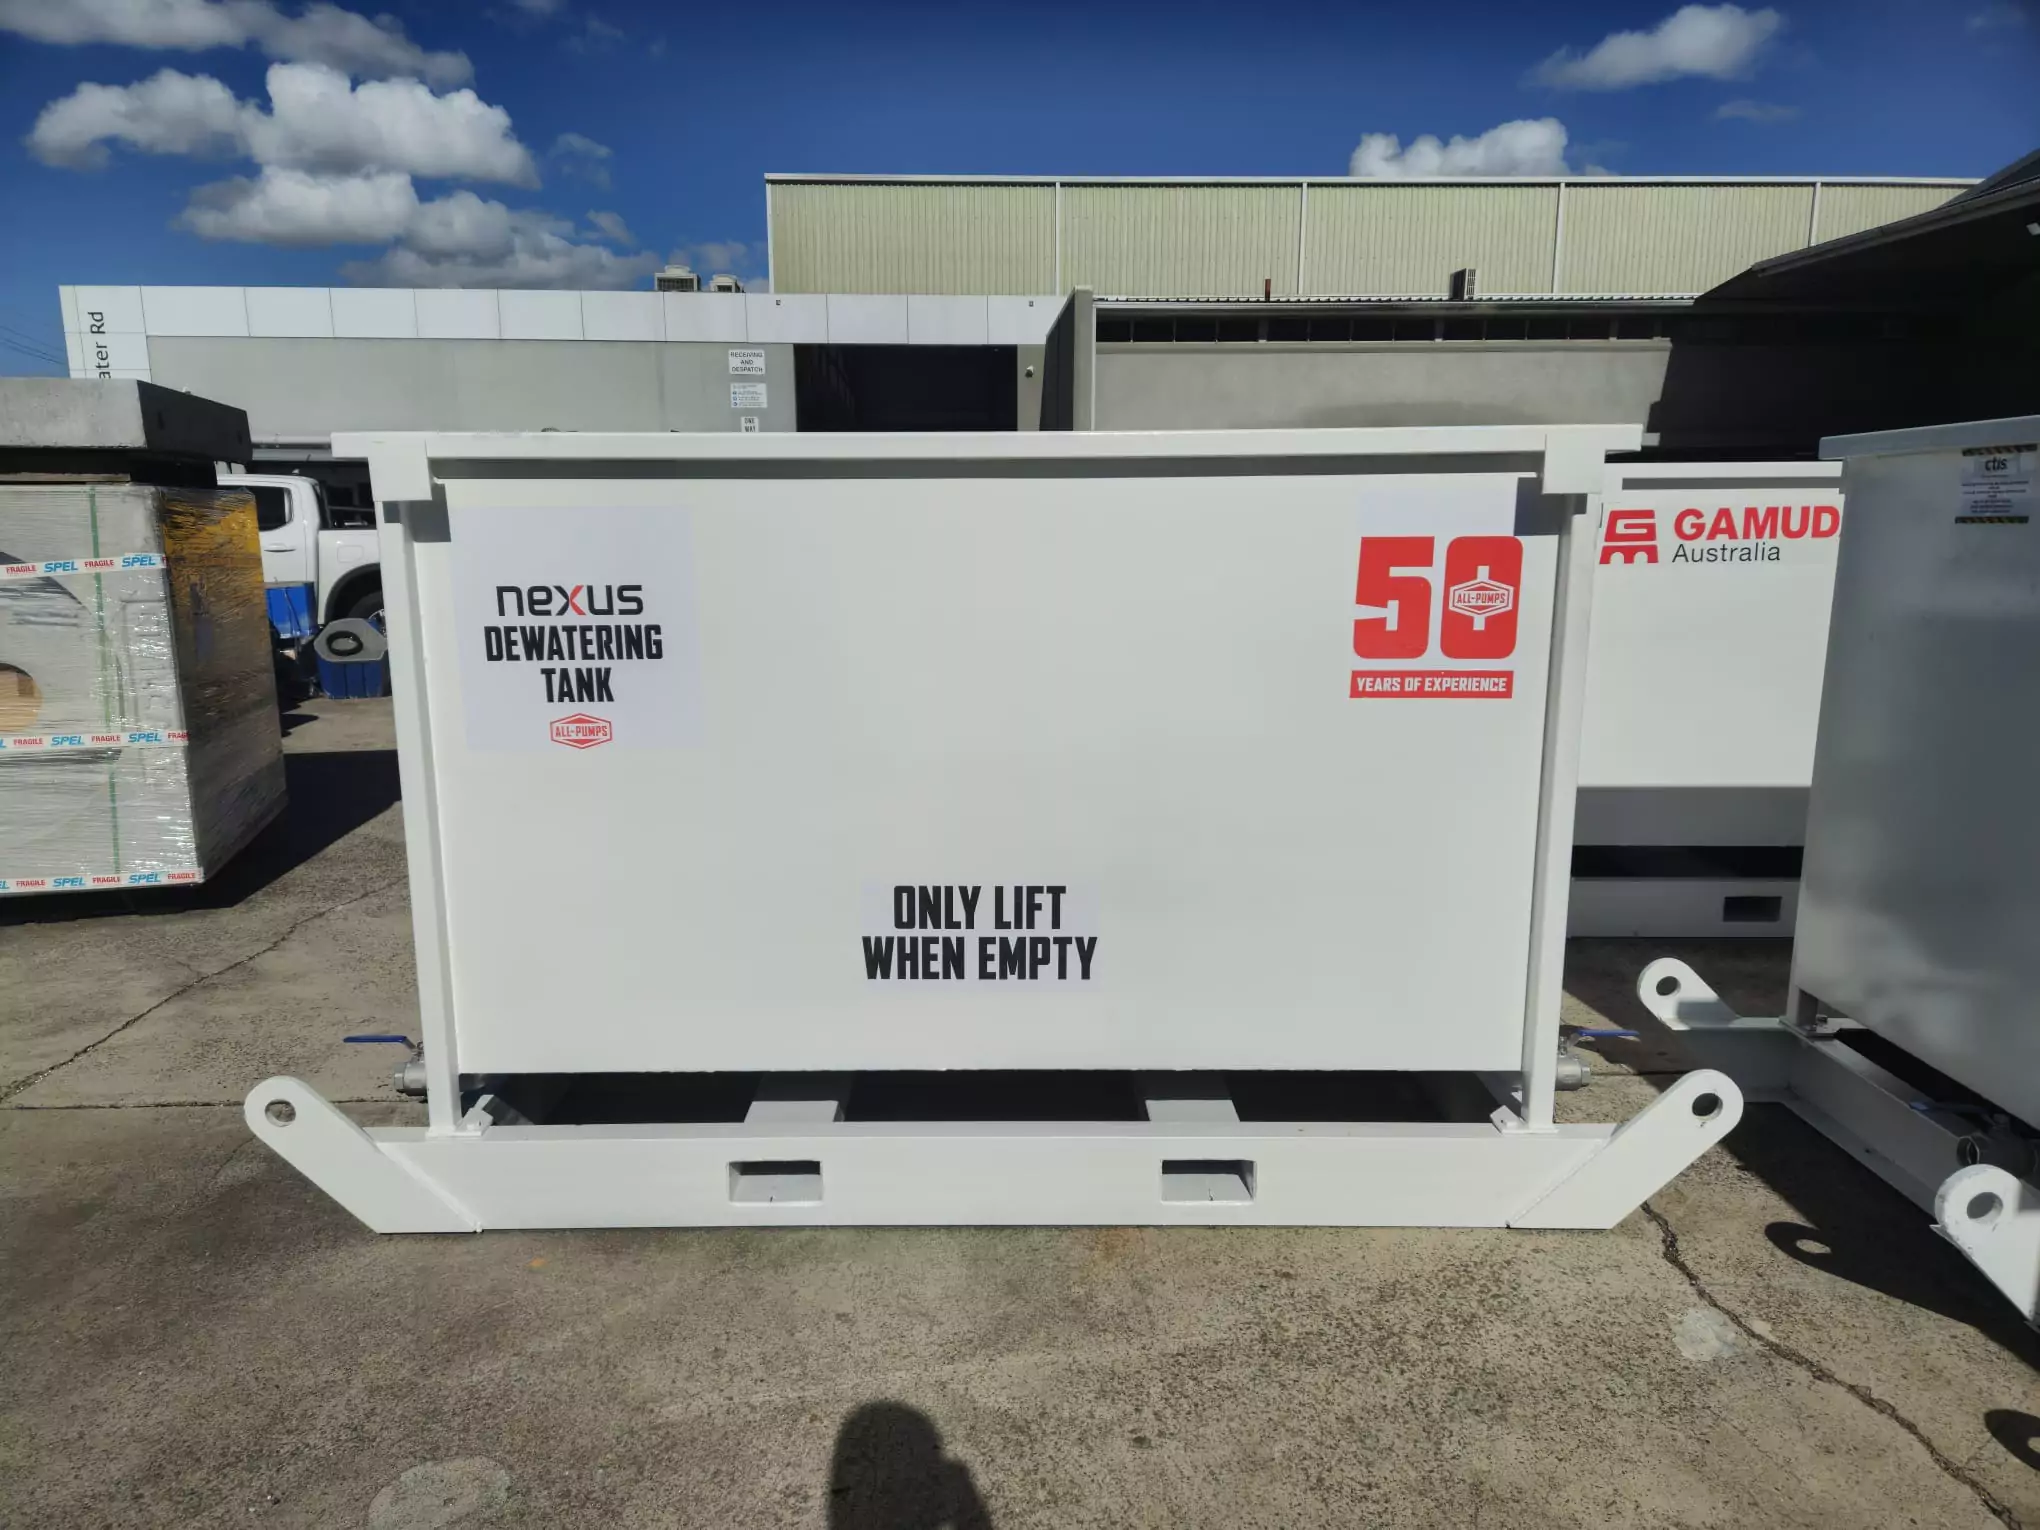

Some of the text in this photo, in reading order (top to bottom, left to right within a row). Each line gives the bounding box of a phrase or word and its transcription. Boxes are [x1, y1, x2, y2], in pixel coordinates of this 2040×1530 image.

[87, 311, 106, 334] Rd
[744, 417, 756, 425] ONE
[1673, 505, 1840, 541] GAMUD
[1671, 541, 1781, 563] Australia
[6, 565, 37, 574] FRAGILE
[43, 561, 78, 573] SPEL
[84, 559, 114, 568] FRAGILE
[121, 555, 156, 568] SPEL
[496, 584, 644, 617] nexus
[1353, 535, 1524, 660] 50
[1456, 591, 1507, 605] ALL-PUMPS
[484, 624, 663, 662] DEWATERING
[540, 667, 615, 703] TANK
[1357, 677, 1508, 692] YEARS OF EXPERIENCE
[13, 738, 43, 746] FRAGILE
[51, 735, 85, 746] SPEL
[91, 734, 121, 742] FRAGILE
[128, 732, 162, 743] SPEL
[555, 725, 608, 738] ALL-PUMPS
[16, 879, 46, 887] FRAGILE
[52, 877, 86, 887] SPEL
[128, 873, 162, 883] SPEL
[168, 872, 195, 880] FRAGILE
[894, 885, 1067, 930] ONLY LIFT
[862, 936, 1098, 981] WHEN EMPTY
